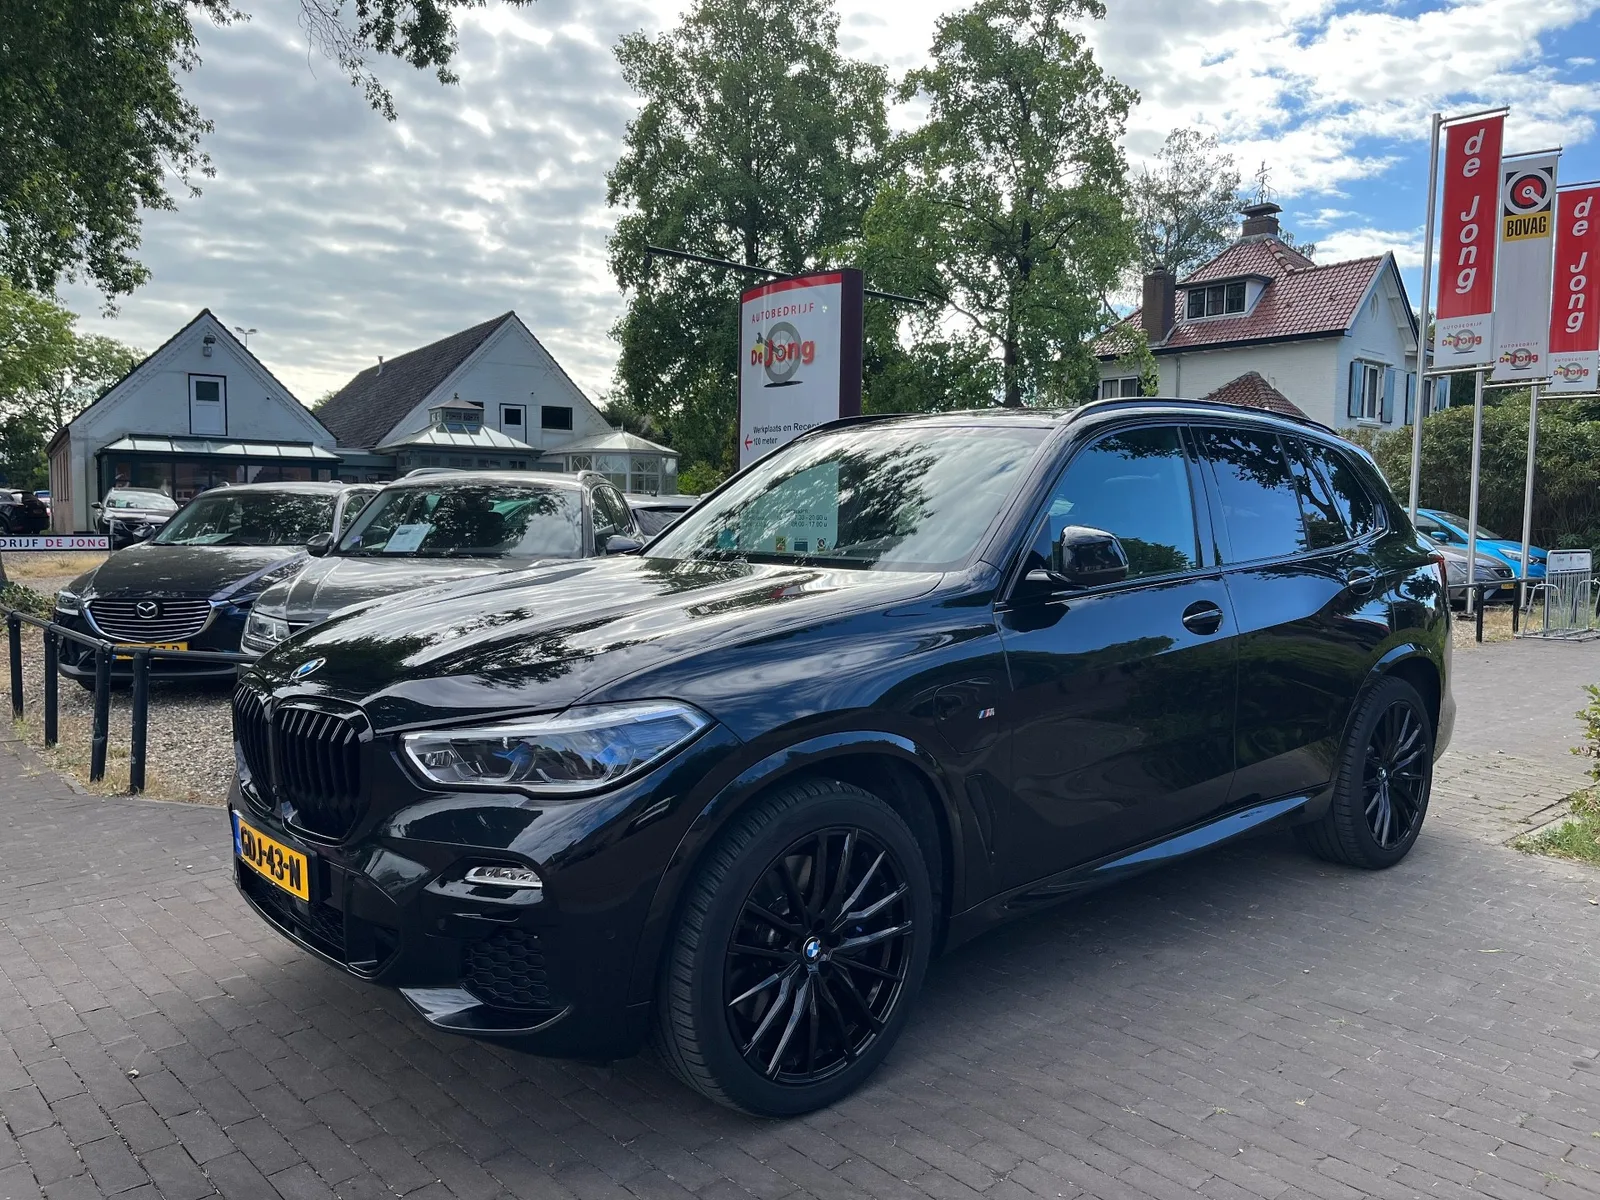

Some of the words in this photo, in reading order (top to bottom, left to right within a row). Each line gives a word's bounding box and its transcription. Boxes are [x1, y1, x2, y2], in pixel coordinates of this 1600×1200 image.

[1463, 128, 1485, 178] de
[1506, 215, 1547, 238] BOVAG
[1572, 196, 1593, 237] de
[1455, 195, 1480, 295] Jong
[1565, 252, 1588, 333] Jong
[751, 302, 815, 324] AUTOBEDRIJF
[751, 349, 763, 367] De
[764, 338, 815, 368] Jong
[753, 424, 782, 434] Werkplaats
[793, 422, 822, 431] Rece
[762, 437, 778, 445] meter
[0, 538, 39, 548] DRIJF
[45, 538, 63, 548] DE
[69, 538, 107, 548] JONG
[240, 826, 302, 891] GDJ-43-N
